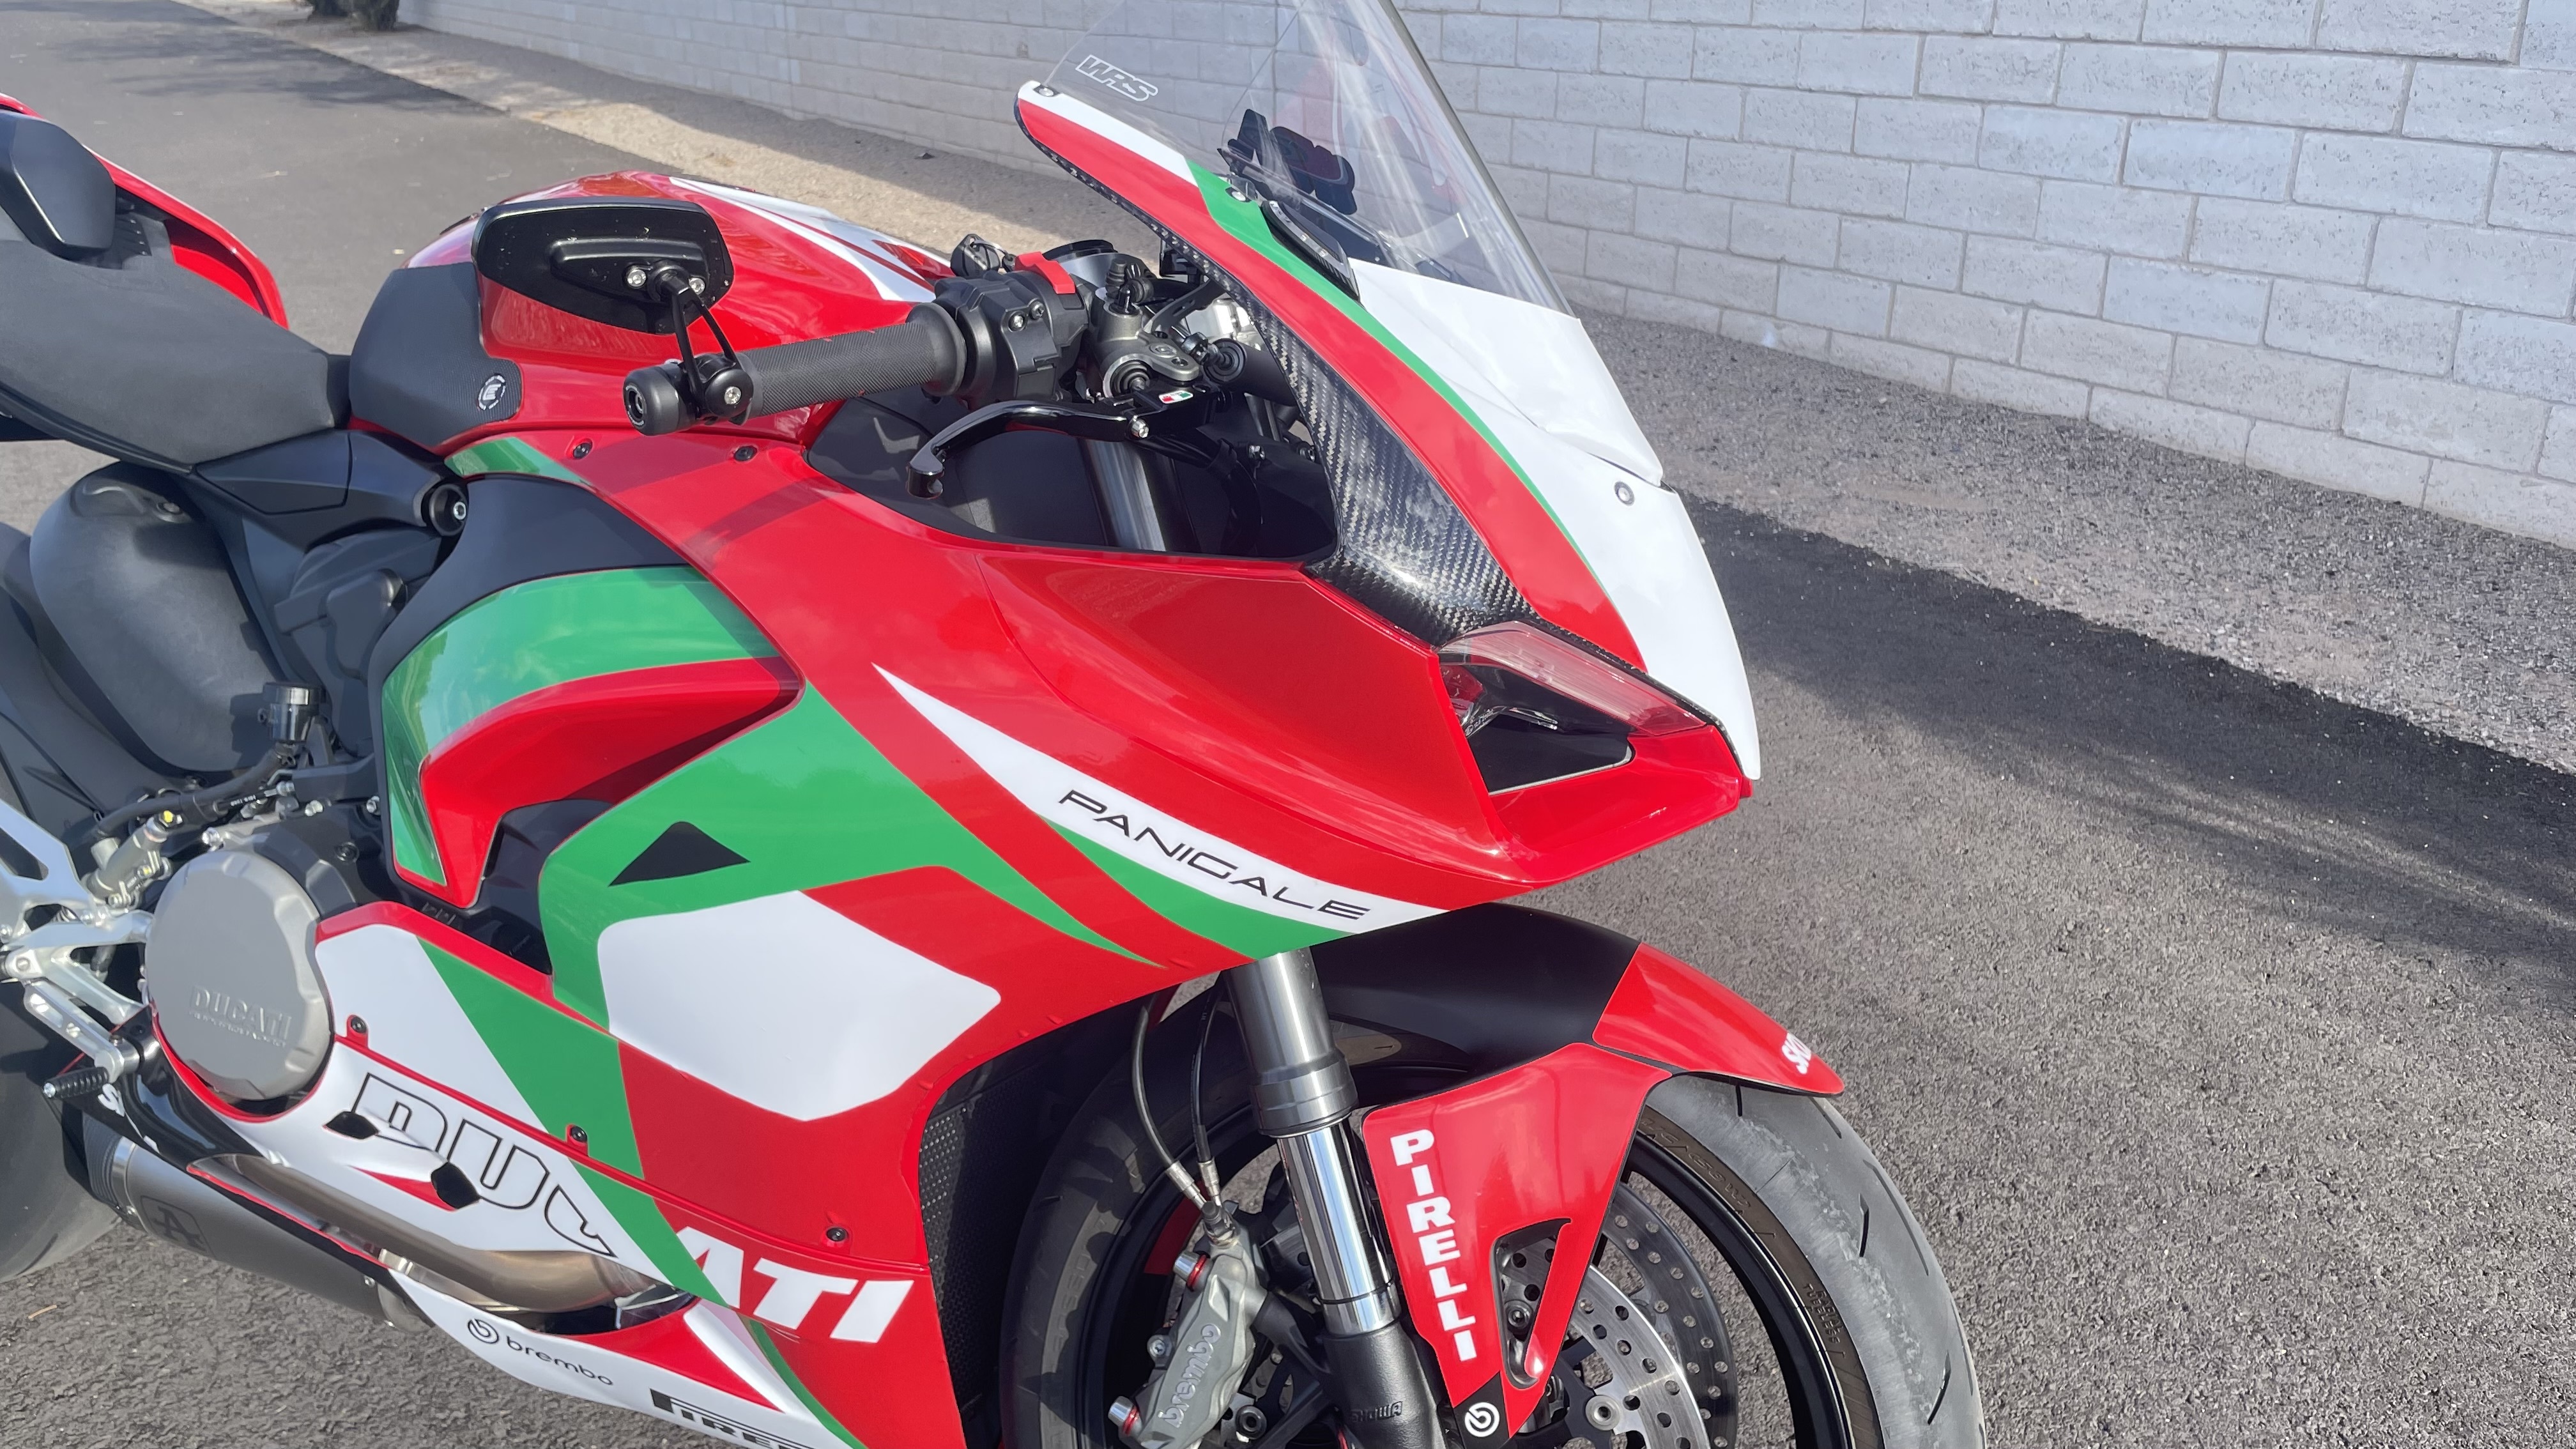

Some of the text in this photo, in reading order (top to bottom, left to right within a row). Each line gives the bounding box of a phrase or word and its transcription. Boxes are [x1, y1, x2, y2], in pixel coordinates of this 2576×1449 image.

[1075, 54, 1159, 102] WRS
[1058, 789, 1371, 921] PANIGALE
[190, 985, 291, 1040] DUCATI
[1390, 1129, 1477, 1361] PIRELLI
[506, 1335, 614, 1386] brembo
[1158, 1323, 1222, 1429] brembo
